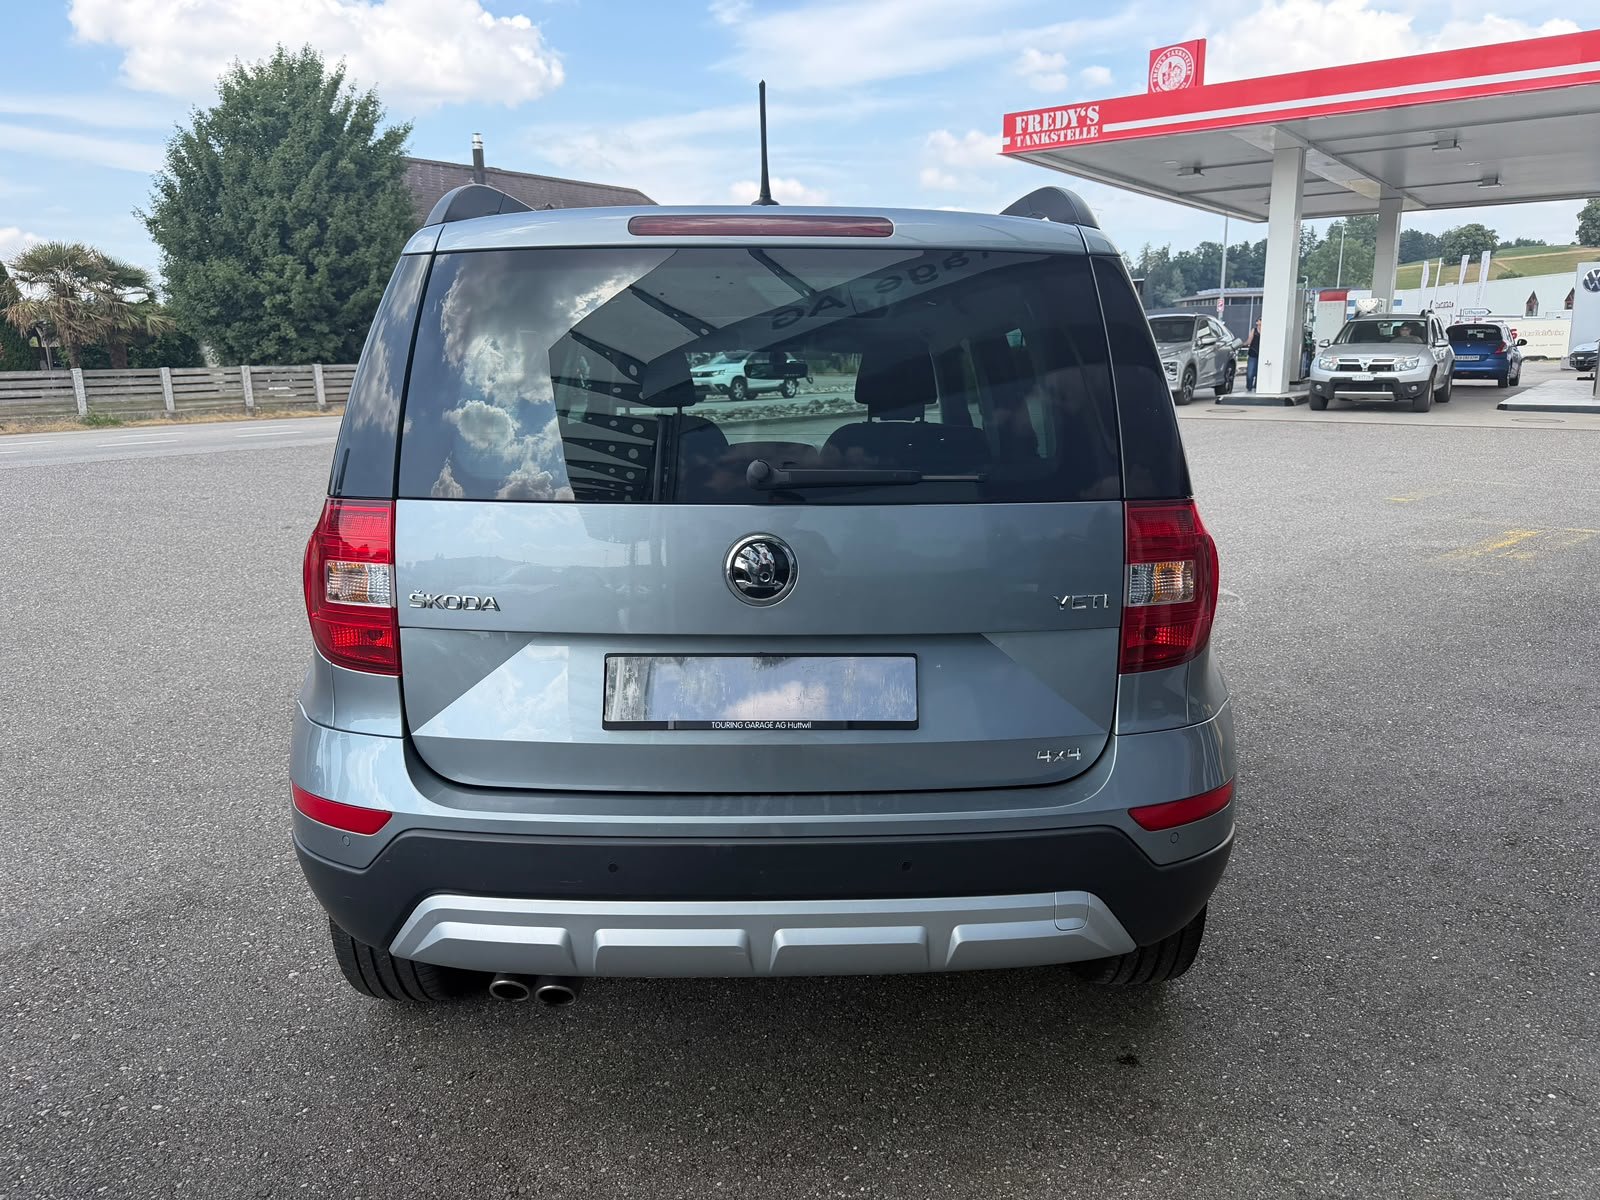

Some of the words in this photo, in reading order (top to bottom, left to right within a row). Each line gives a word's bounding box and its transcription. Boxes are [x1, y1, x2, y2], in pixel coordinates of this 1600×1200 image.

[1014, 125, 1099, 147] TANKSTELLE
[409, 589, 501, 612] ŠKODA
[1052, 594, 1109, 610] YETI
[711, 721, 743, 729] TOURING
[744, 721, 773, 729] GARAGE
[775, 721, 786, 729] AG
[787, 721, 812, 729] Huttwil
[1036, 747, 1081, 763] 4x4
